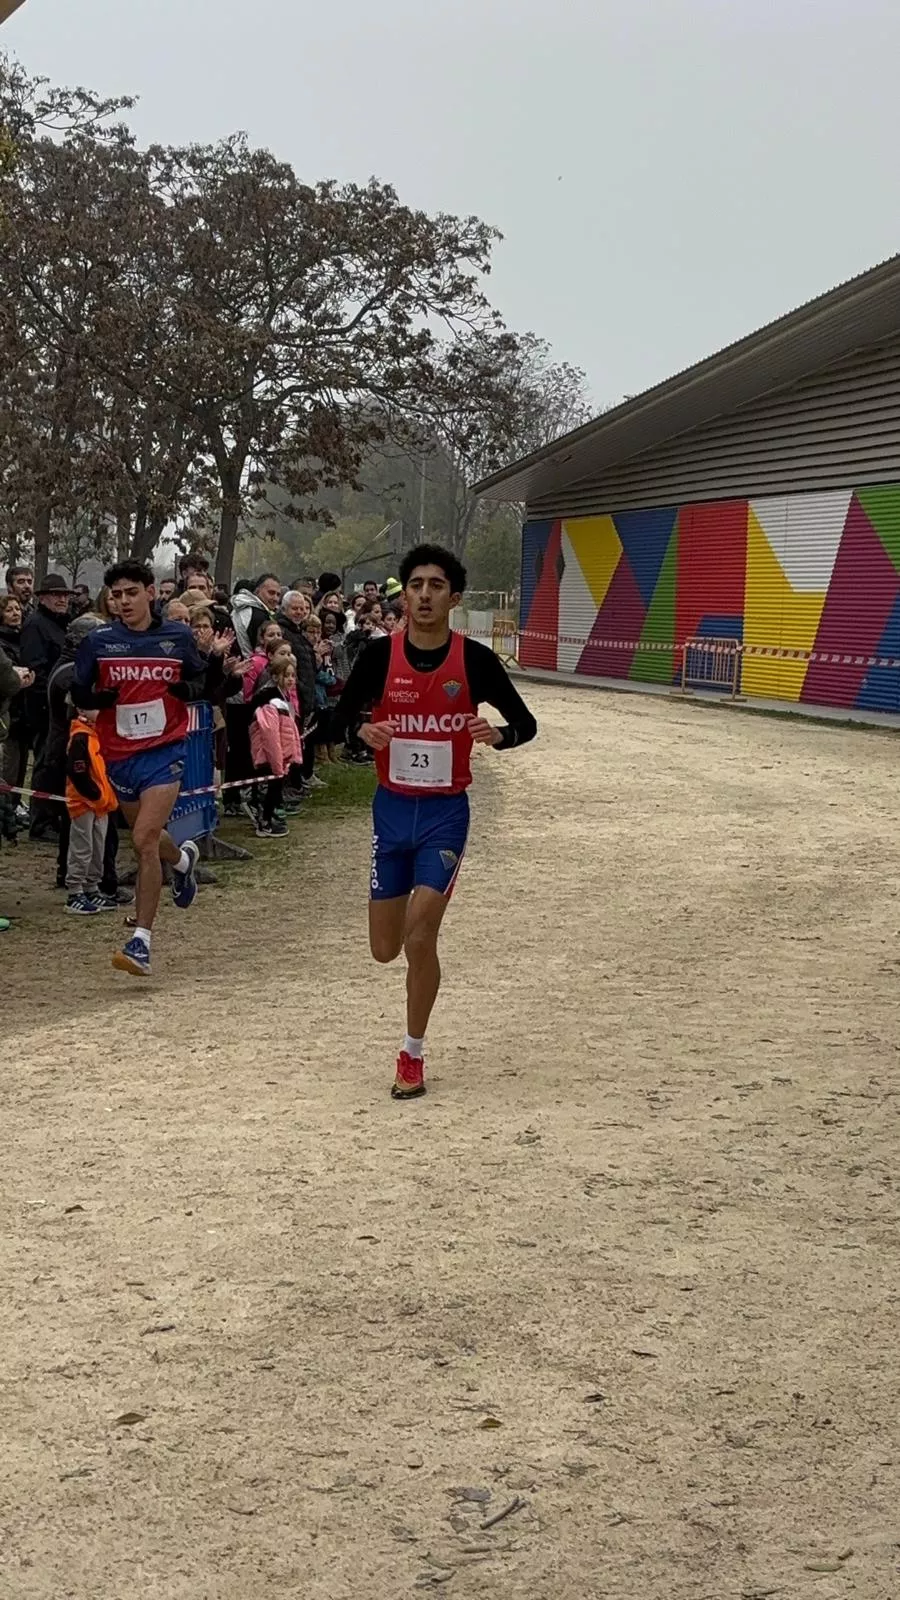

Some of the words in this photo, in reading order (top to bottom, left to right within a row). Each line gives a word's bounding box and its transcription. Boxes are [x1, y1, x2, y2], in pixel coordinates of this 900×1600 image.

[109, 665, 174, 681] HINACO
[134, 712, 147, 725] 17
[410, 752, 429, 768] 23
